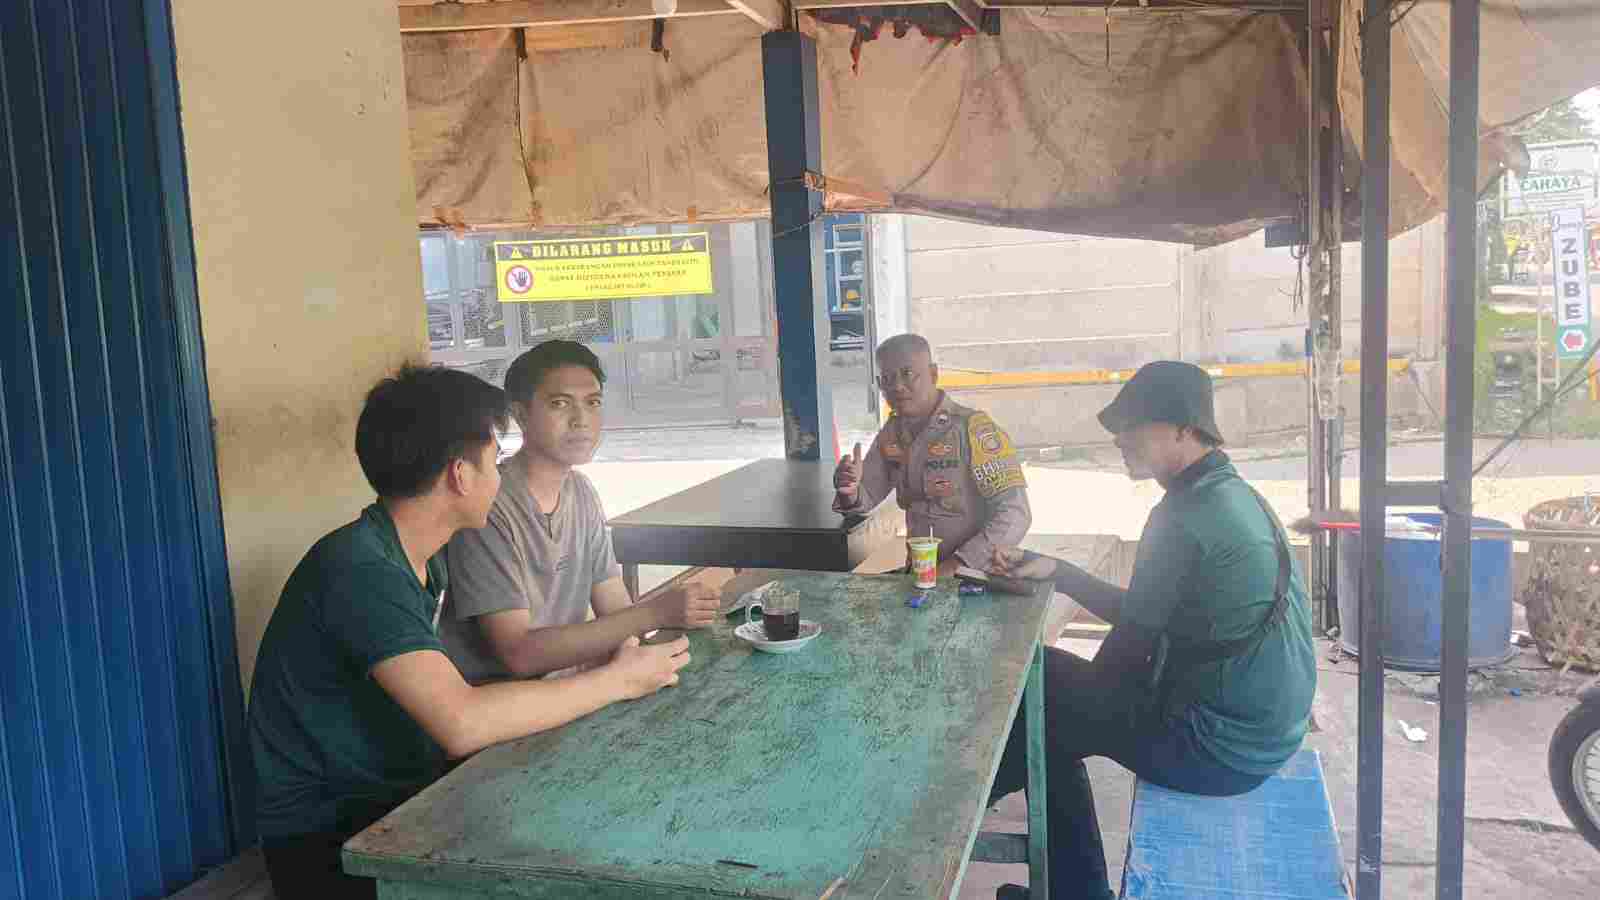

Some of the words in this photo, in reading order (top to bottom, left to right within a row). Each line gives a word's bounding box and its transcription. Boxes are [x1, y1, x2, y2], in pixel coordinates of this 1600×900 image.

[1519, 175, 1581, 192] CAHAYA
[531, 241, 611, 258] DILARANG
[617, 239, 671, 255] MASUK
[1561, 237, 1583, 320] ZUBE
